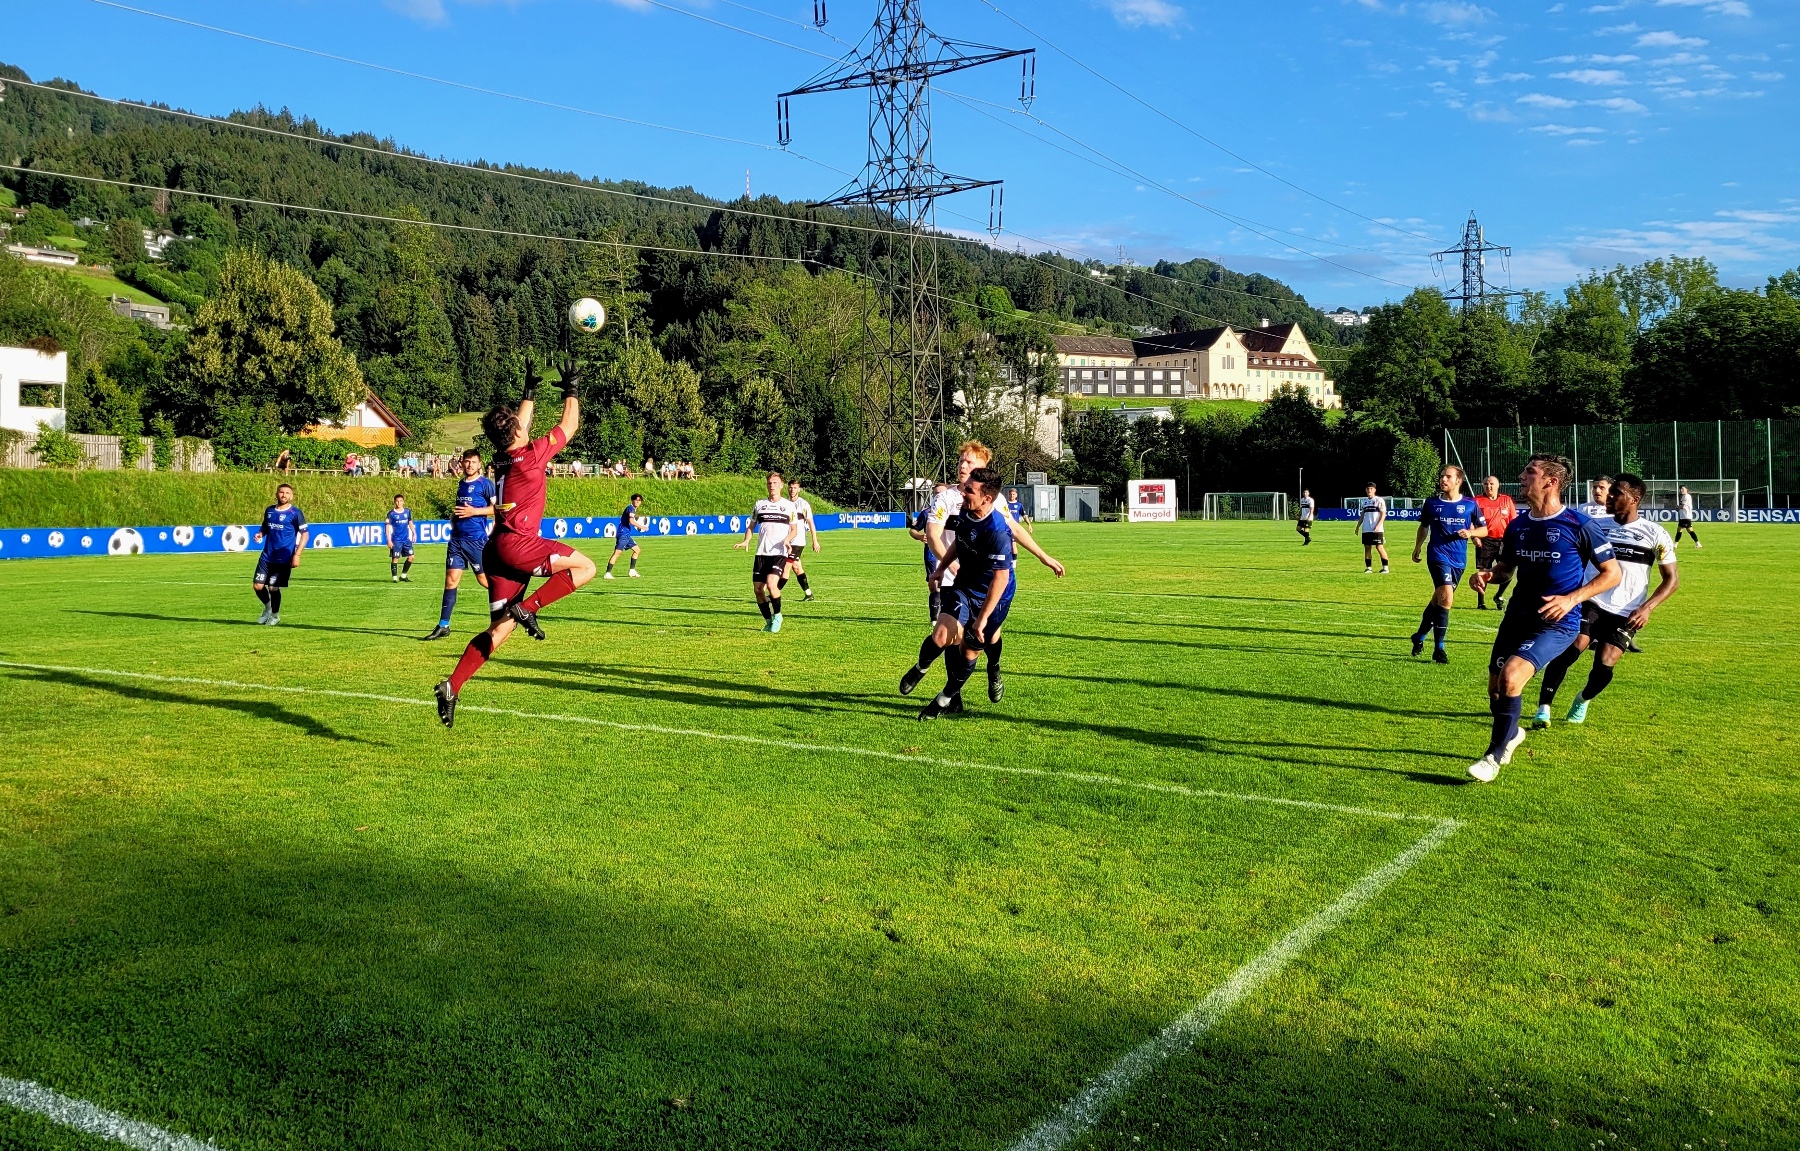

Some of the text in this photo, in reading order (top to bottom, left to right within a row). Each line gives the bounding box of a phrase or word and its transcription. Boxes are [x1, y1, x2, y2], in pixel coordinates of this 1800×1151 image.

[497, 475, 505, 505] 1
[1133, 510, 1171, 520] Mangold
[1346, 508, 1357, 517] SV
[1637, 509, 1712, 522] EMOTON
[838, 513, 847, 524] SV
[847, 513, 872, 529] typico
[1439, 516, 1466, 525] typico
[348, 525, 382, 544] WIR
[420, 523, 452, 542] EUC
[1519, 532, 1525, 541] 6
[1520, 548, 1562, 562] typico
[255, 573, 265, 581] 28
[953, 600, 963, 611] 7
[1496, 656, 1505, 669] 6
